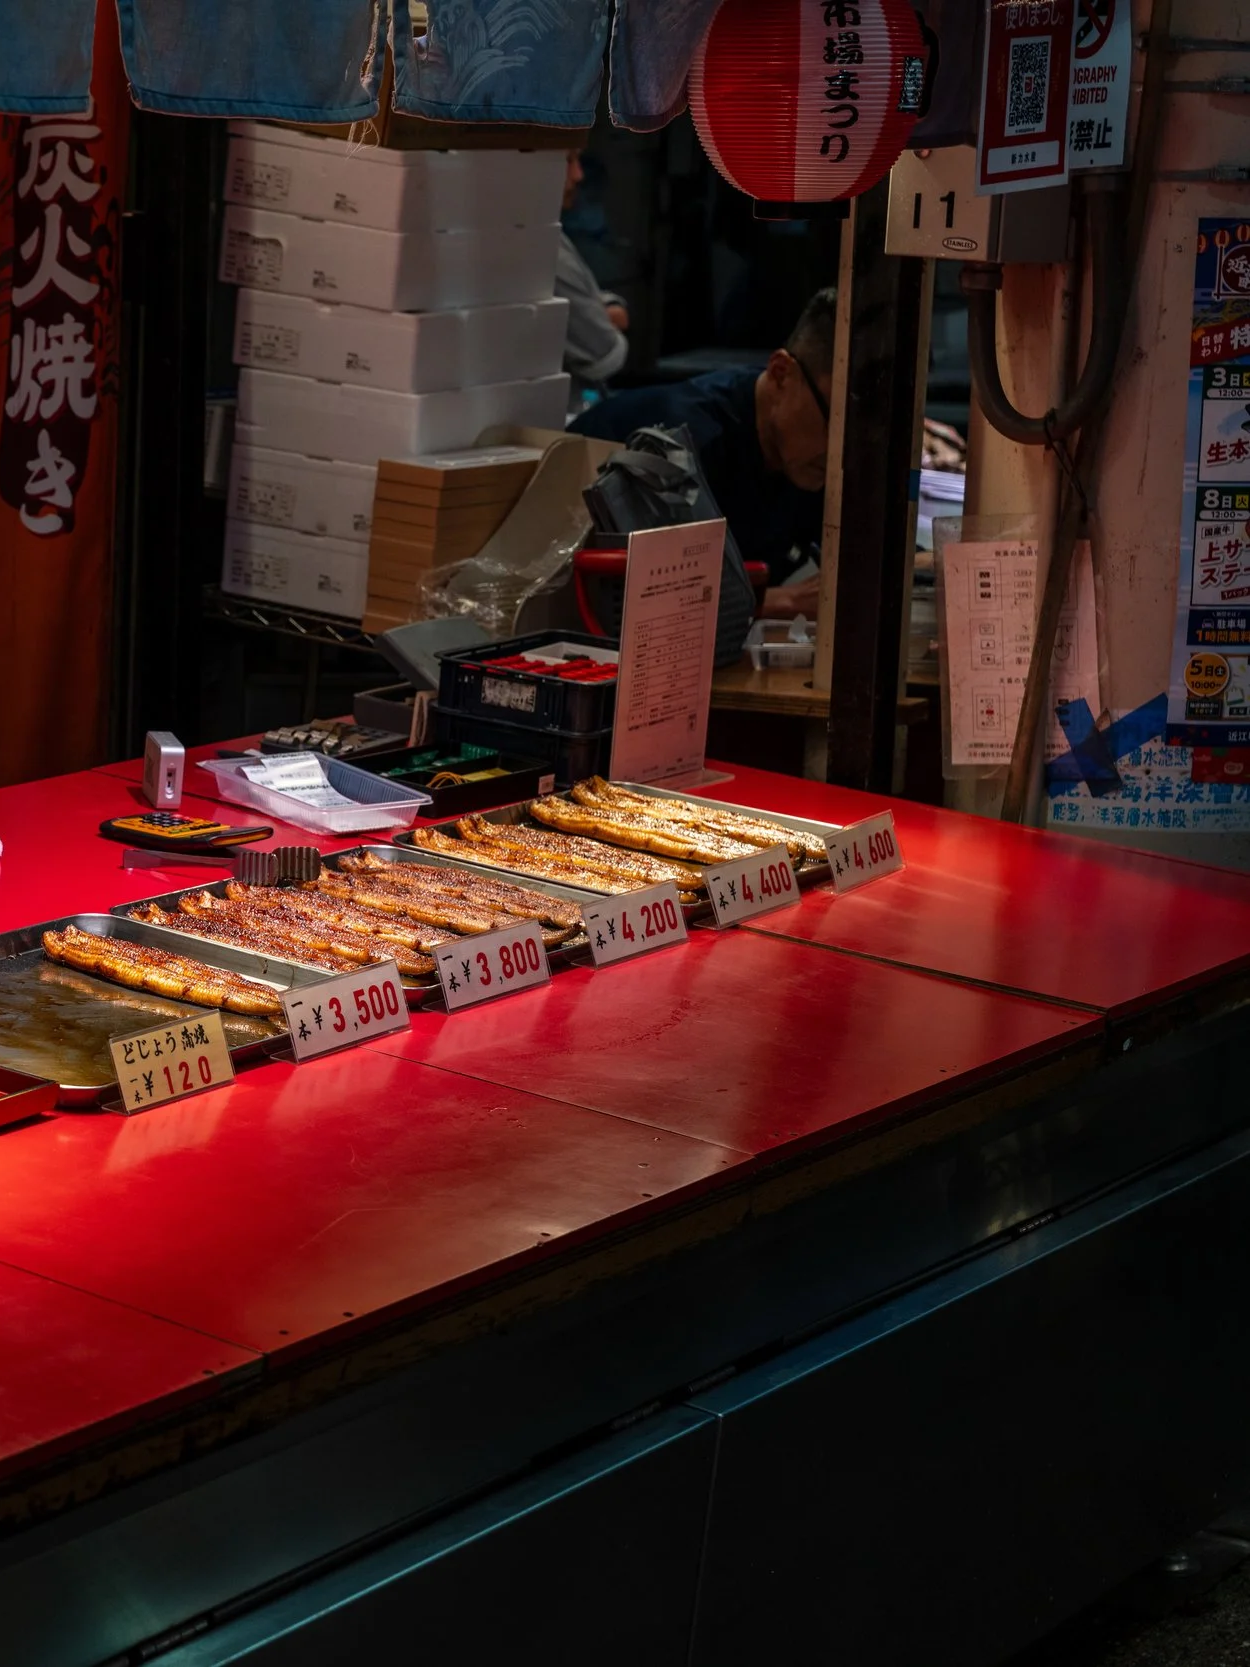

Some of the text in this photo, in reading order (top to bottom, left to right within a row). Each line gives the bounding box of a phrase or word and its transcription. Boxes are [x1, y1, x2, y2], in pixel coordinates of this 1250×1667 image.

[820, 0, 864, 163] 市場まつり
[842, 829, 894, 869] ¥4,600
[712, 861, 792, 910] 一本 ¥4,400
[590, 898, 678, 949] 一本 ¥4,200
[442, 938, 540, 992] 一本 ¥3,800
[291, 980, 399, 1041] 一本 ¥3,500
[142, 1055, 212, 1097] ¥120
